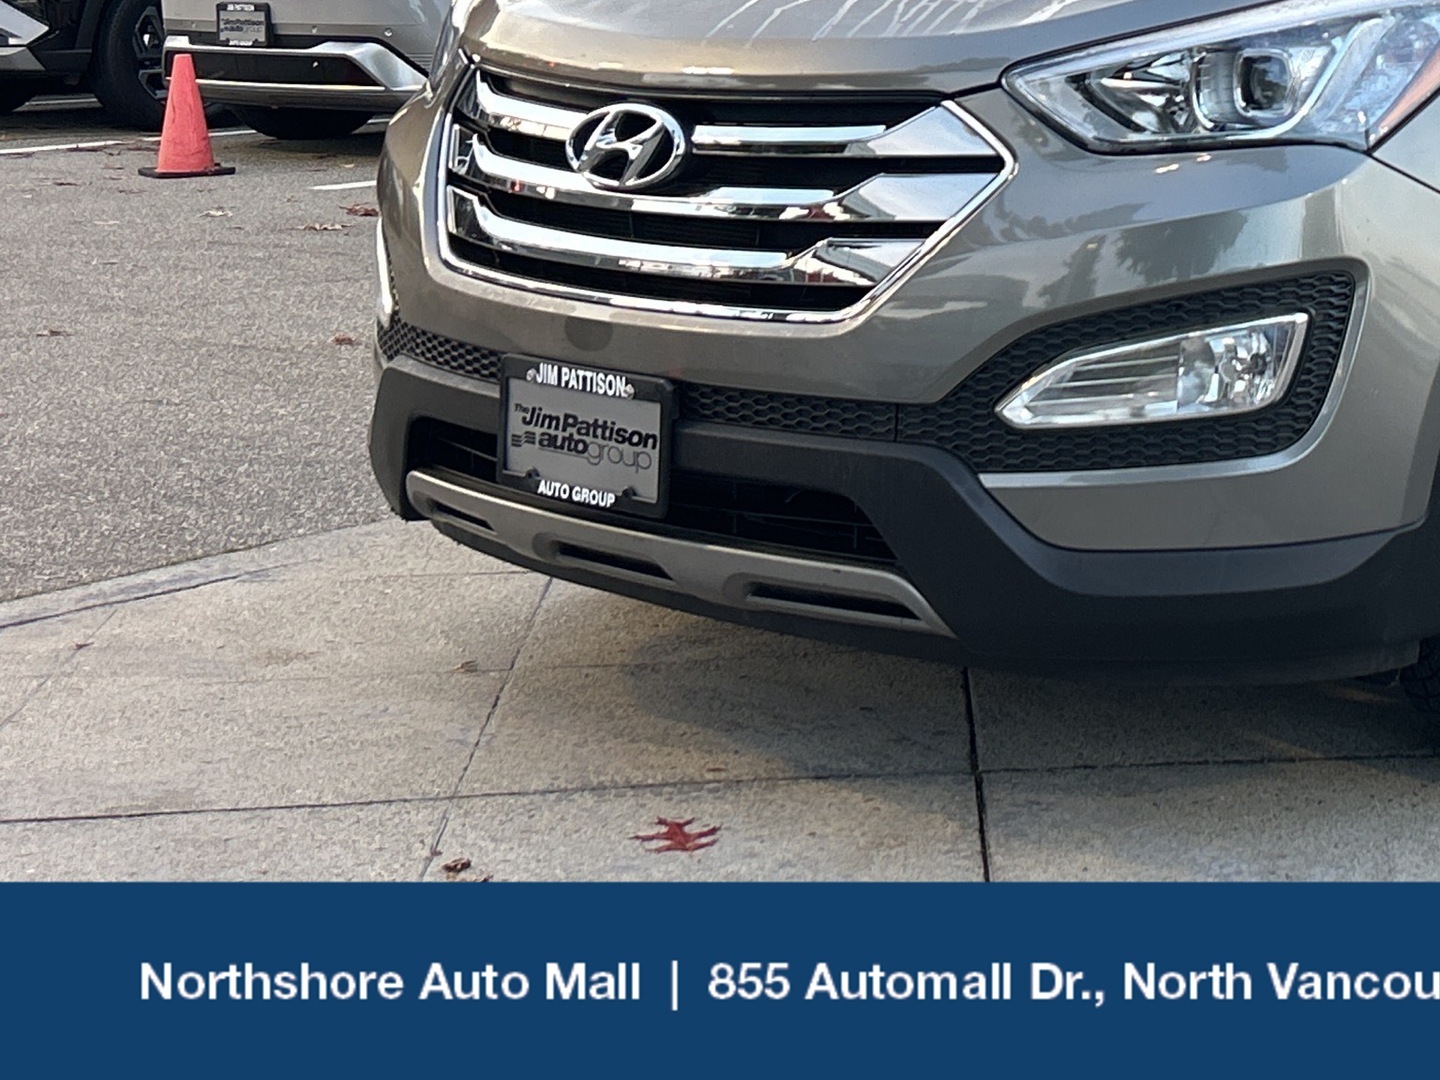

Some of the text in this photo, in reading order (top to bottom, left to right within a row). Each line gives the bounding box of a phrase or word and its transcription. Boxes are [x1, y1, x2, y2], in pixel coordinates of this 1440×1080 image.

[536, 362, 628, 397] JIM PATTISON
[513, 402, 530, 415] The
[537, 479, 616, 508] AUTO GROUP
